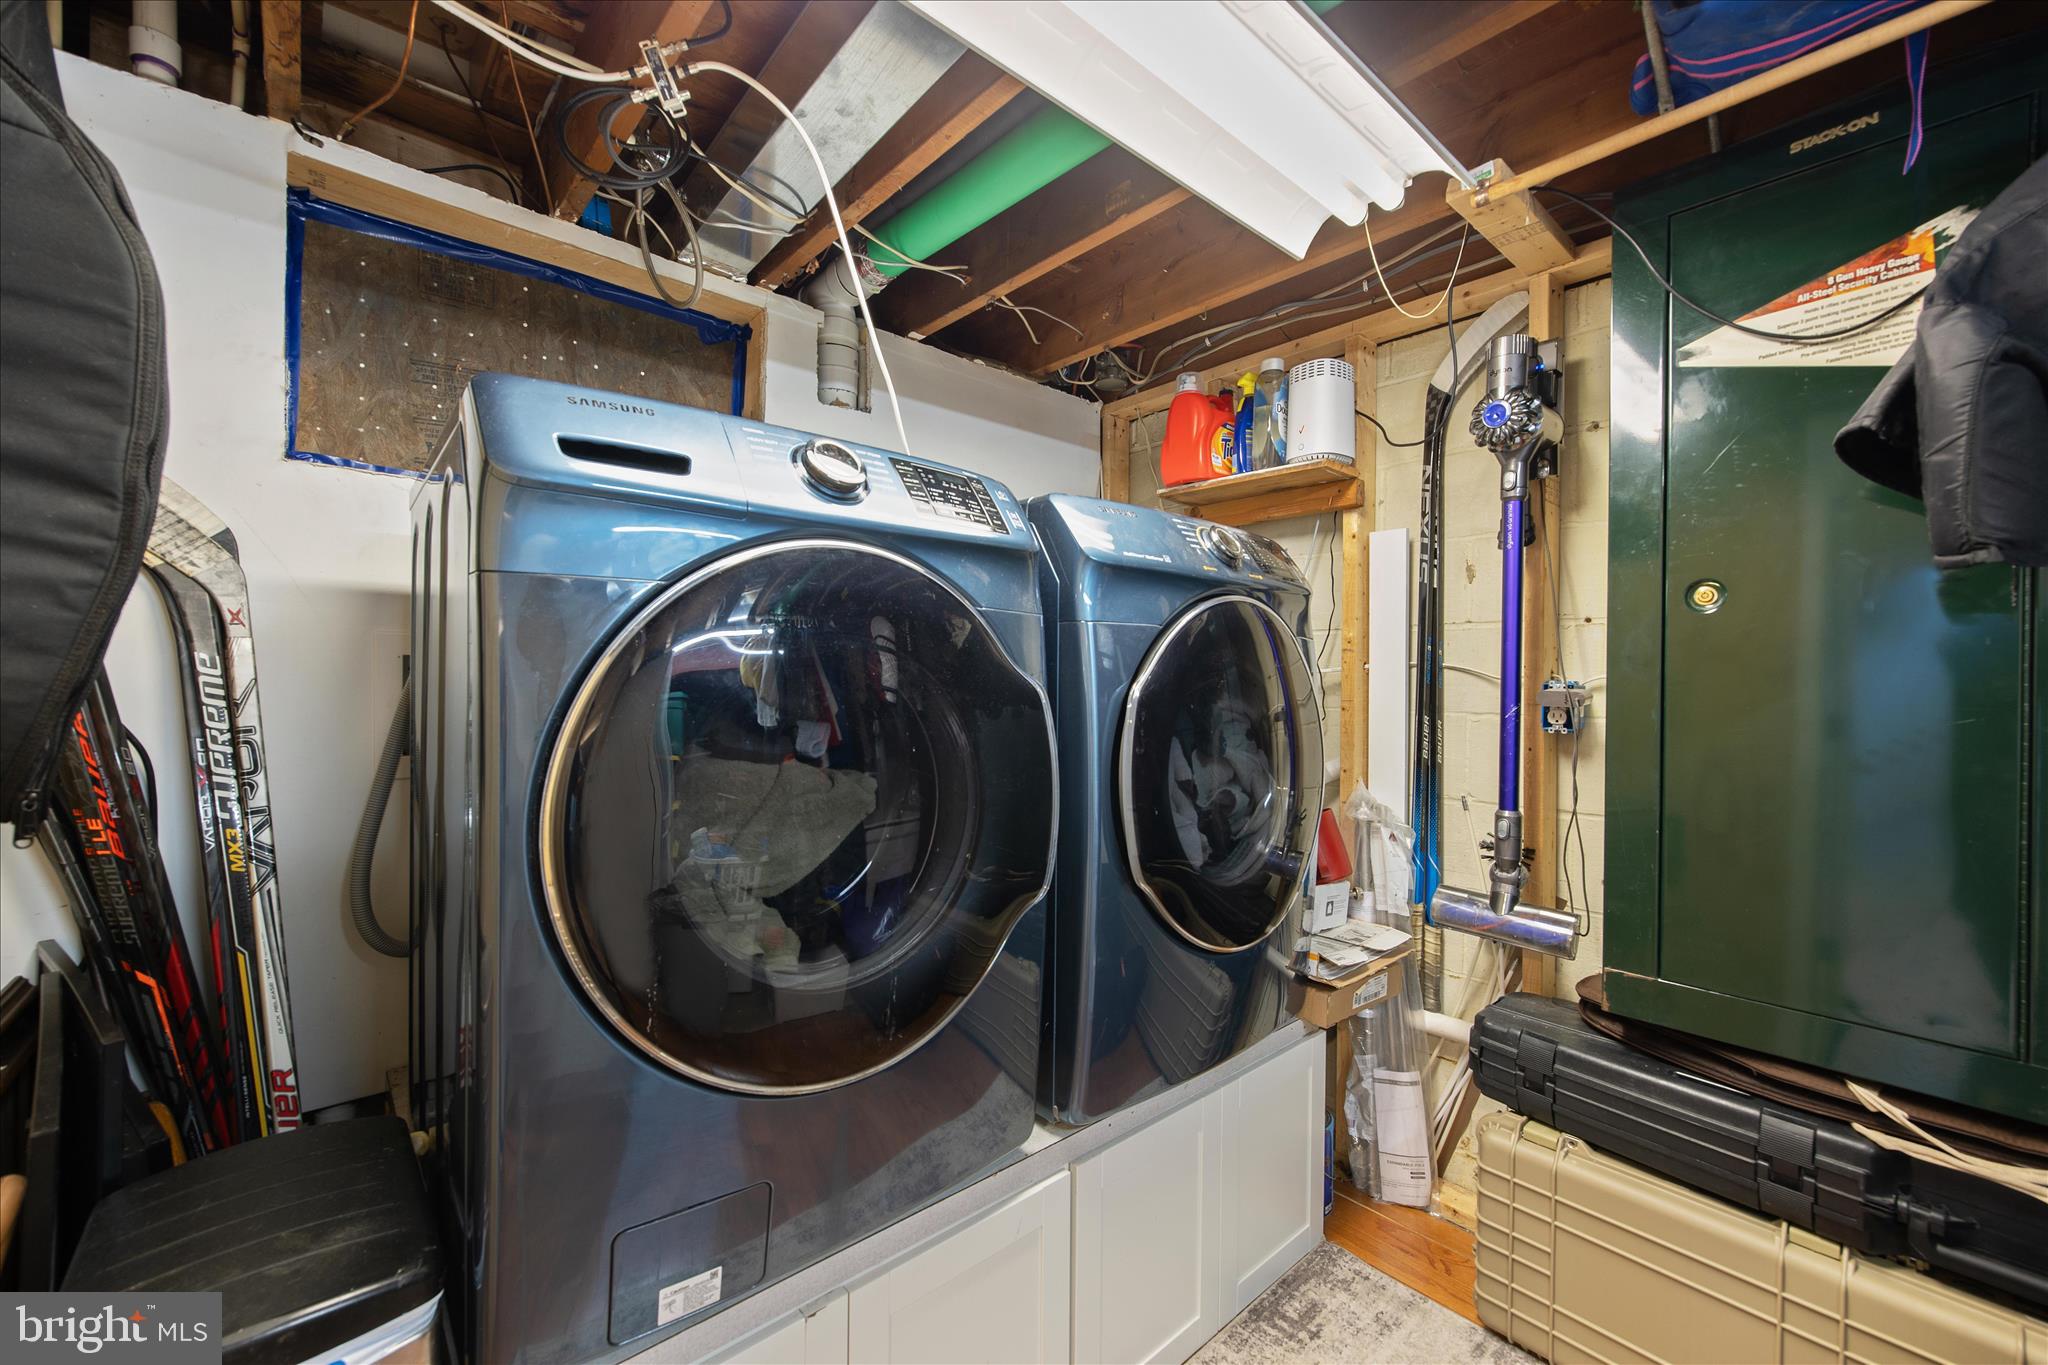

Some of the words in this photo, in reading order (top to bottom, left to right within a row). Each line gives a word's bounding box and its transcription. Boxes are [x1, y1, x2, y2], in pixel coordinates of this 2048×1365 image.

[1790, 111, 1880, 155] STACK-ON
[1796, 285, 1837, 304] All-Steel
[1838, 274, 1878, 293] Security
[1880, 262, 1921, 281] Cabinet
[1826, 275, 1835, 286] 8
[1836, 269, 1855, 284] Gun
[1856, 260, 1886, 278] Heavy
[1887, 253, 1921, 269] Gauge
[566, 396, 656, 417] SAMSUNG
[194, 650, 243, 828] SUPREME
[1422, 715, 1431, 759] BAUER
[225, 827, 247, 873] MX3
